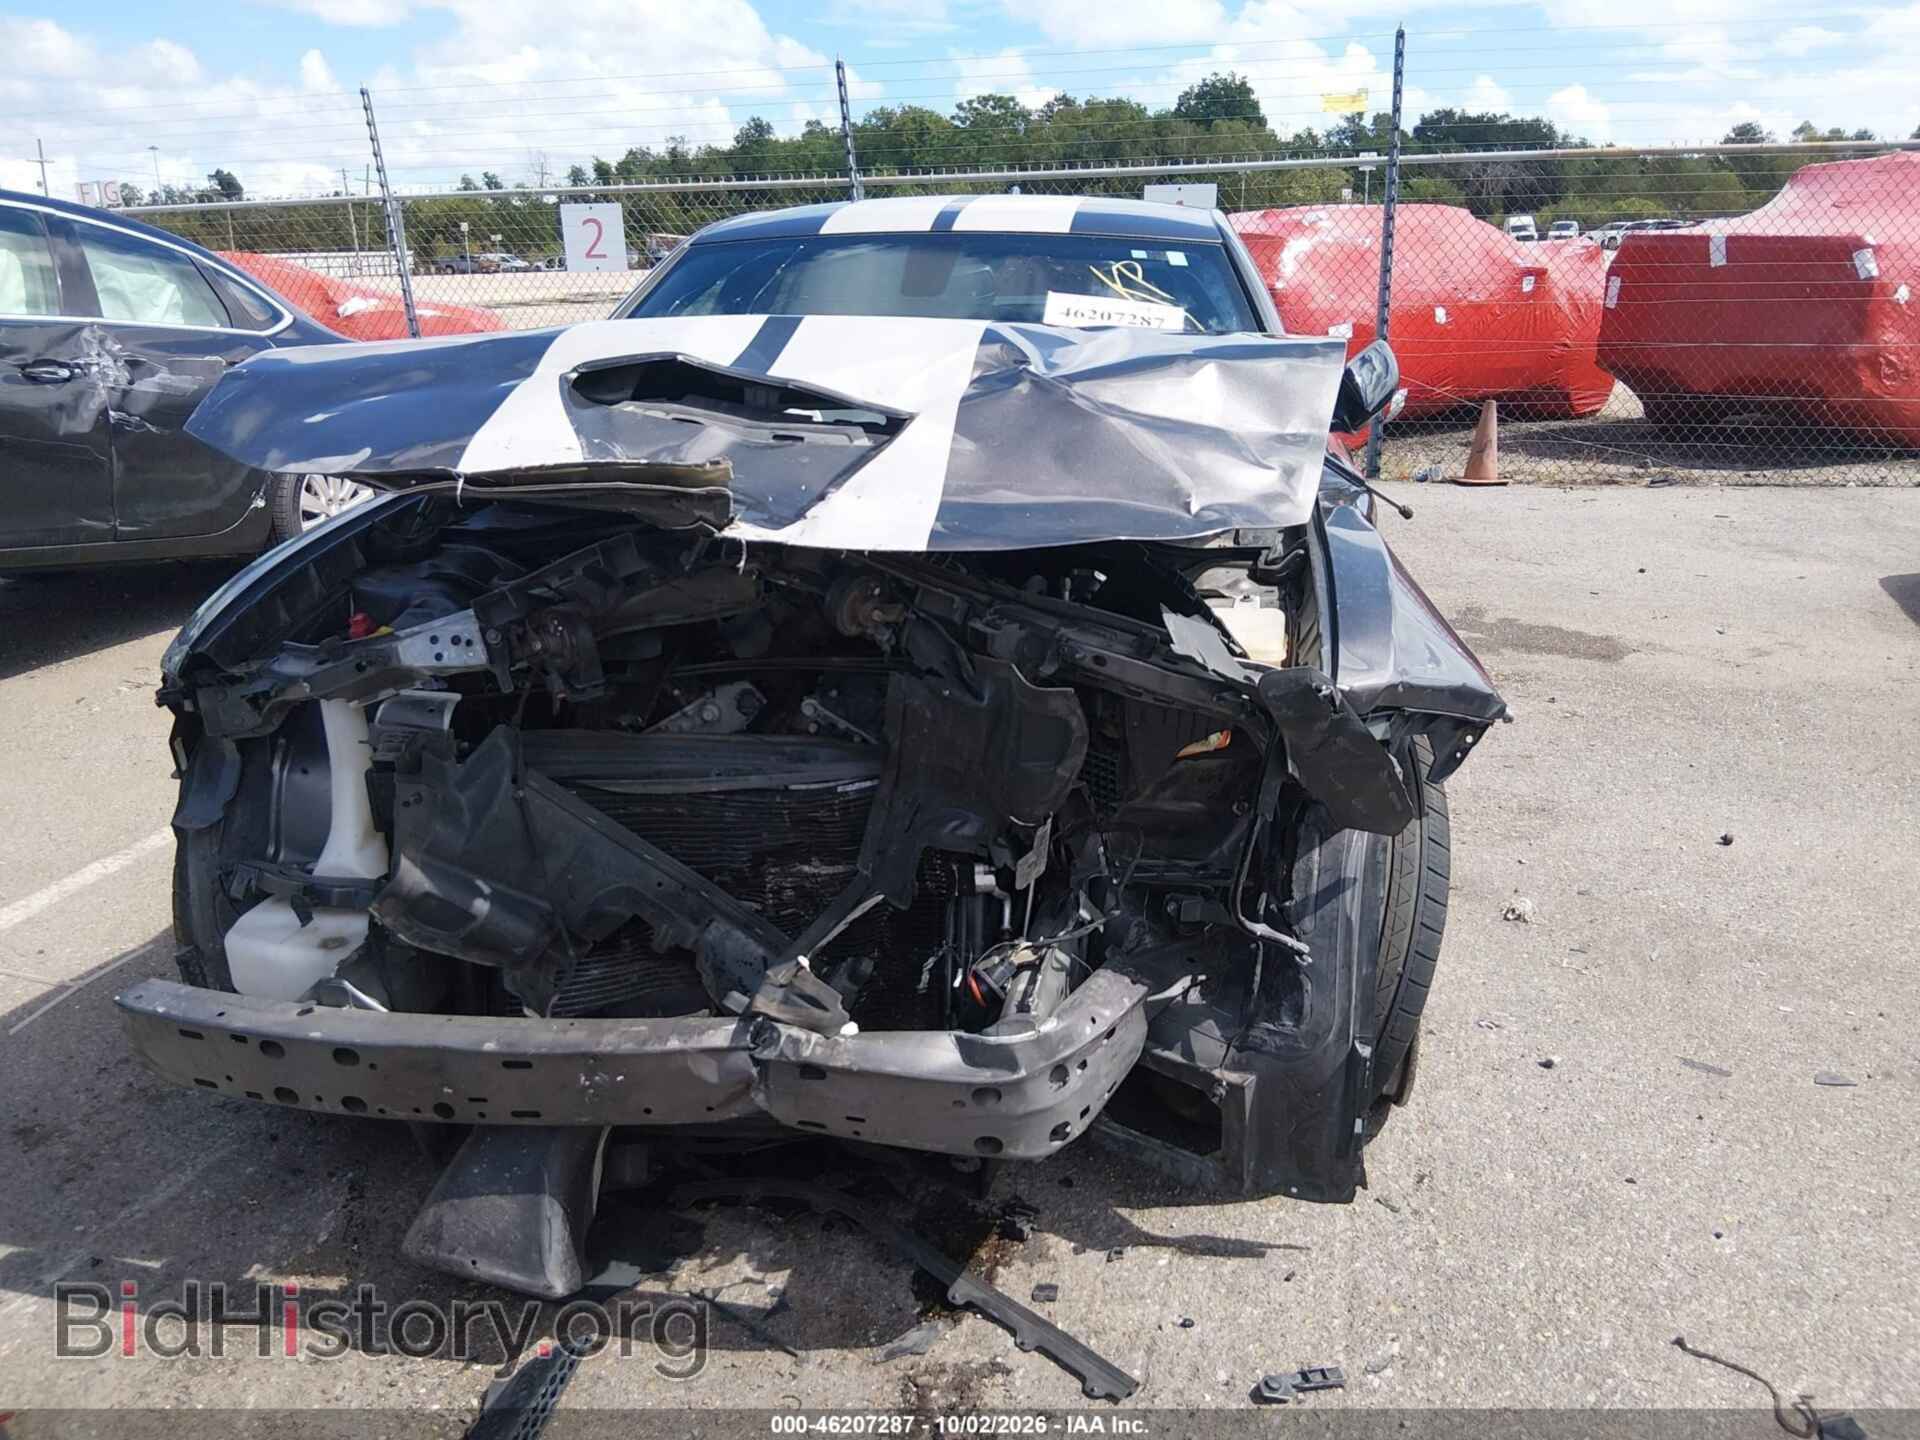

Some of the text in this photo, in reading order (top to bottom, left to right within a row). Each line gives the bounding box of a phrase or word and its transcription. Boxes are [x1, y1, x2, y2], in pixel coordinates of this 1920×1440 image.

[103, 180, 120, 202] G
[582, 217, 607, 259] 2
[1059, 306, 1166, 329] 46207287
